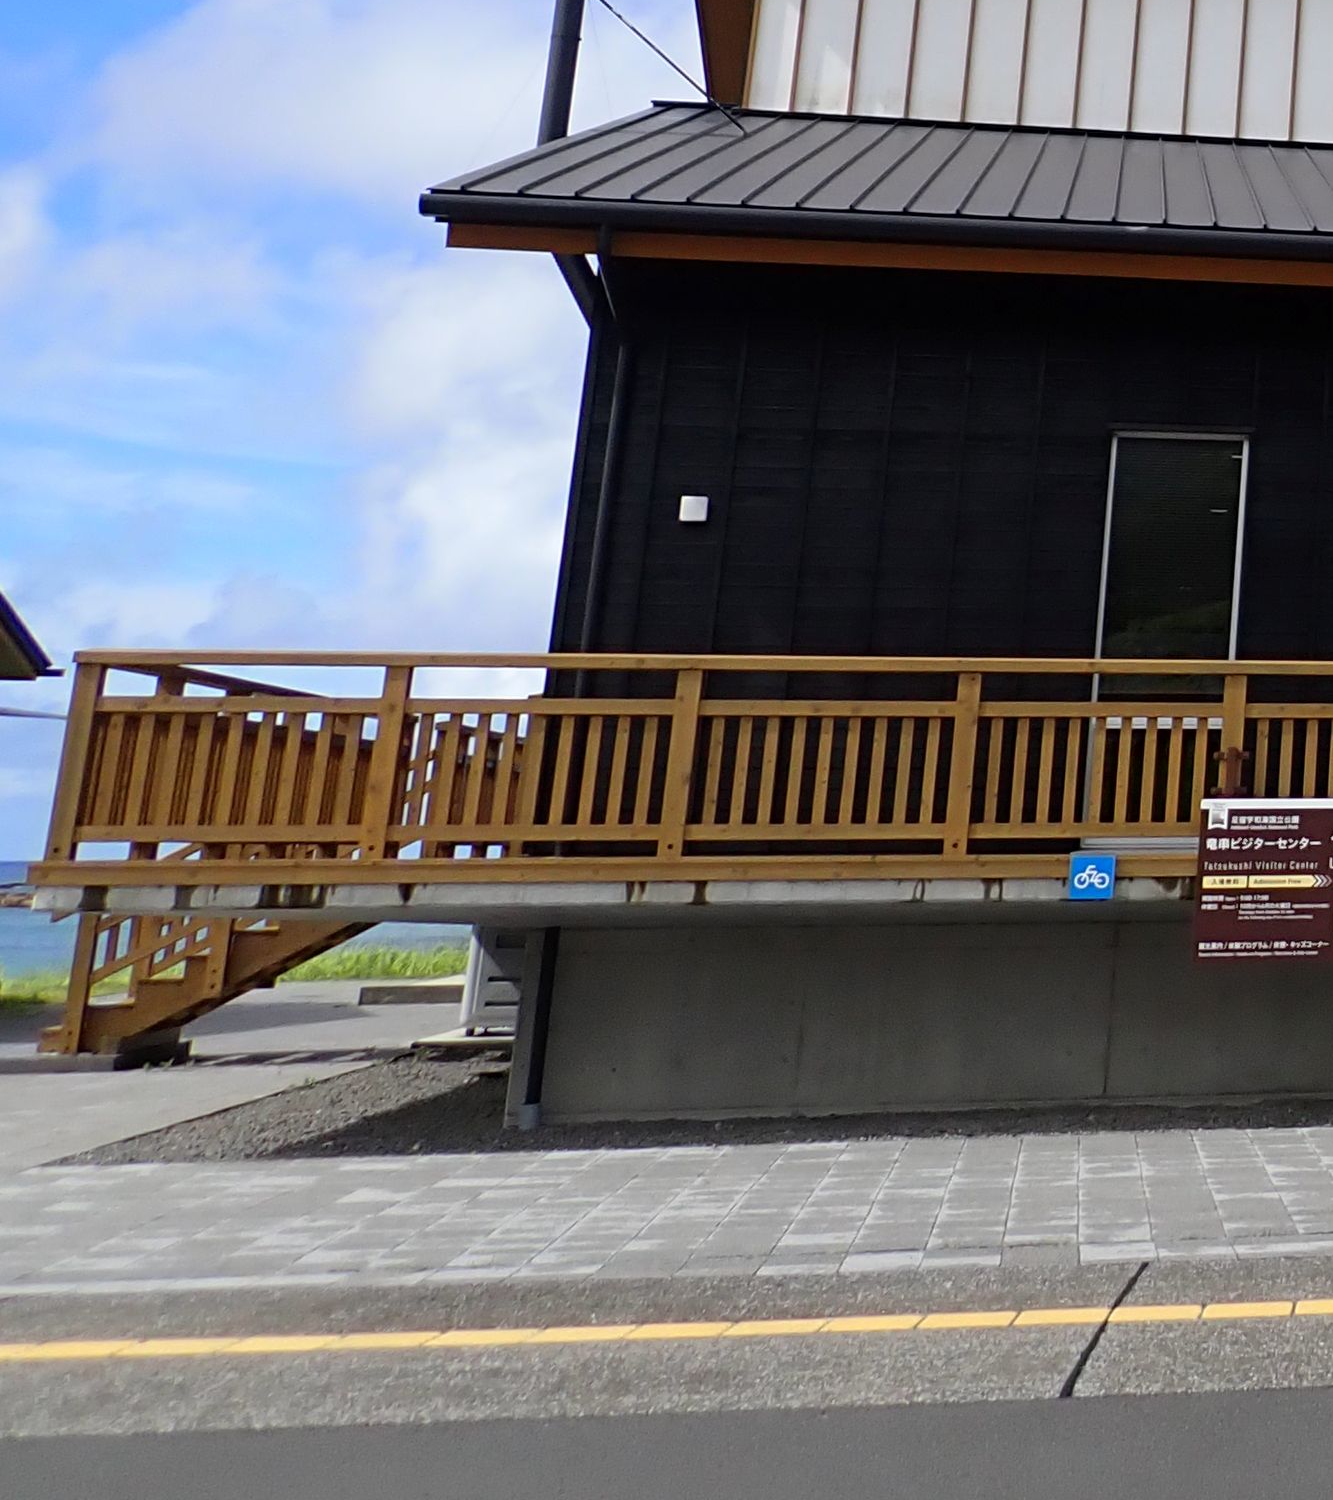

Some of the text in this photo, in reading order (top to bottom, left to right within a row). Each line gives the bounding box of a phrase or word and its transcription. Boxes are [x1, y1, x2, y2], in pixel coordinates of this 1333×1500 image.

[1204, 860, 1319, 871] Tatsukushi Visitor Center
